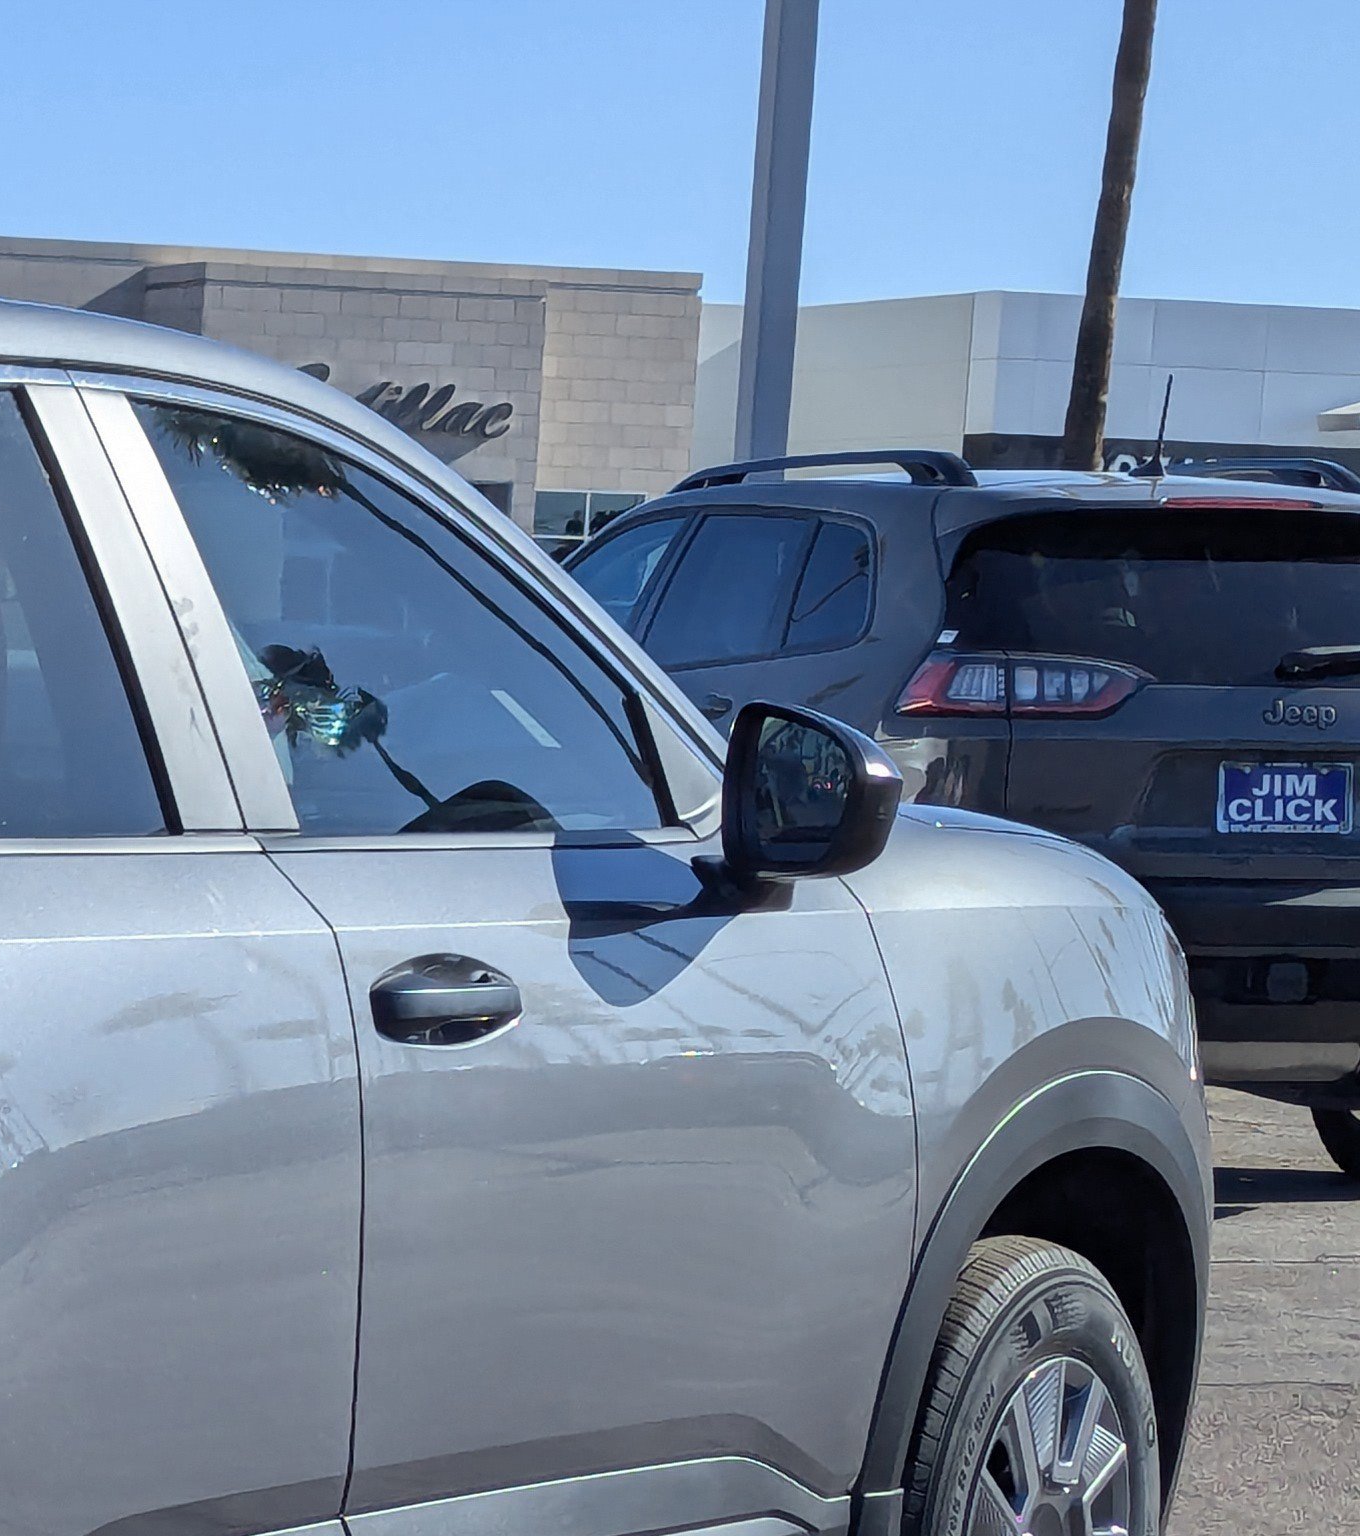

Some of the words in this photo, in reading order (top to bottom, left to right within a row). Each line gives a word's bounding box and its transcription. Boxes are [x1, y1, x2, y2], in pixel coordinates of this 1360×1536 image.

[296, 363, 514, 438] illac
[1263, 699, 1338, 729] Jeep
[1252, 774, 1317, 797] JIM
[1228, 798, 1338, 822] CLICK
